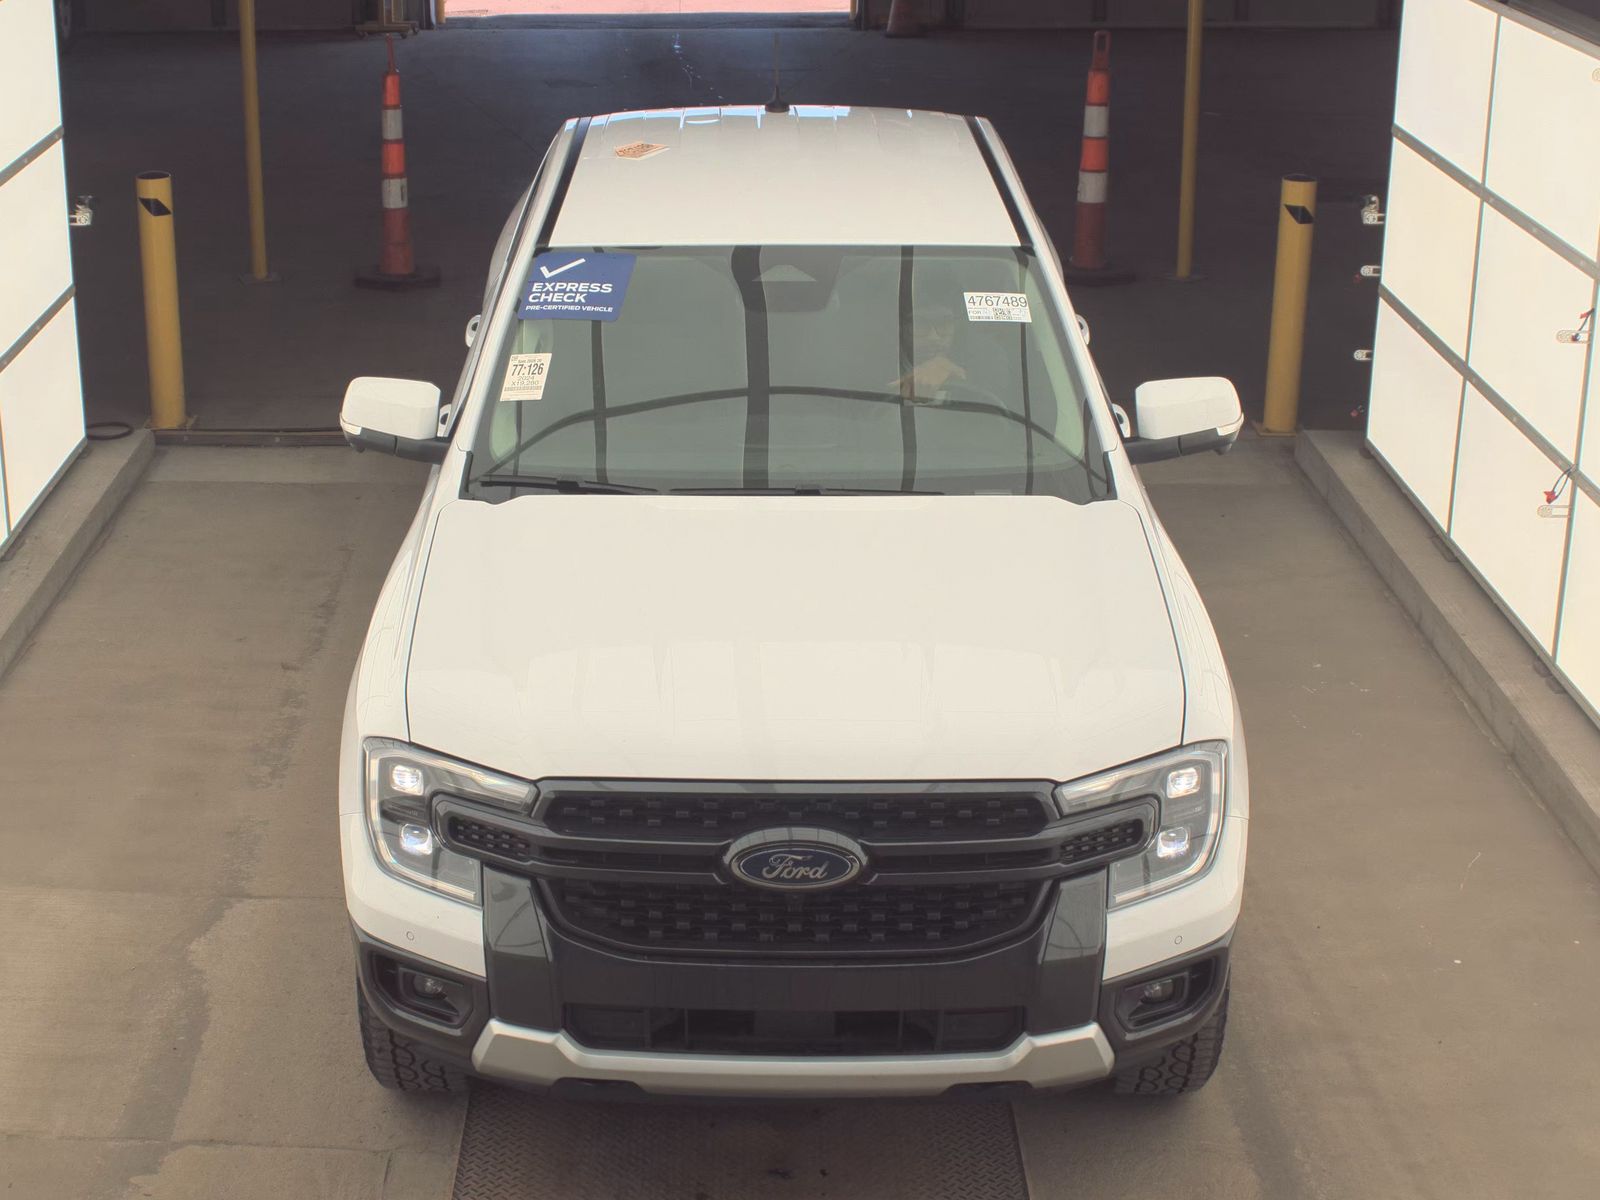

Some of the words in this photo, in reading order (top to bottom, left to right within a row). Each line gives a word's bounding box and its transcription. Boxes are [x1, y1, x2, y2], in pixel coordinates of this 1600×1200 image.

[531, 282, 613, 293] EXPRESS
[528, 292, 588, 303] CHECK
[968, 295, 1028, 308] 4767489
[581, 305, 613, 313] VEHICLE
[762, 853, 829, 879] Ford
